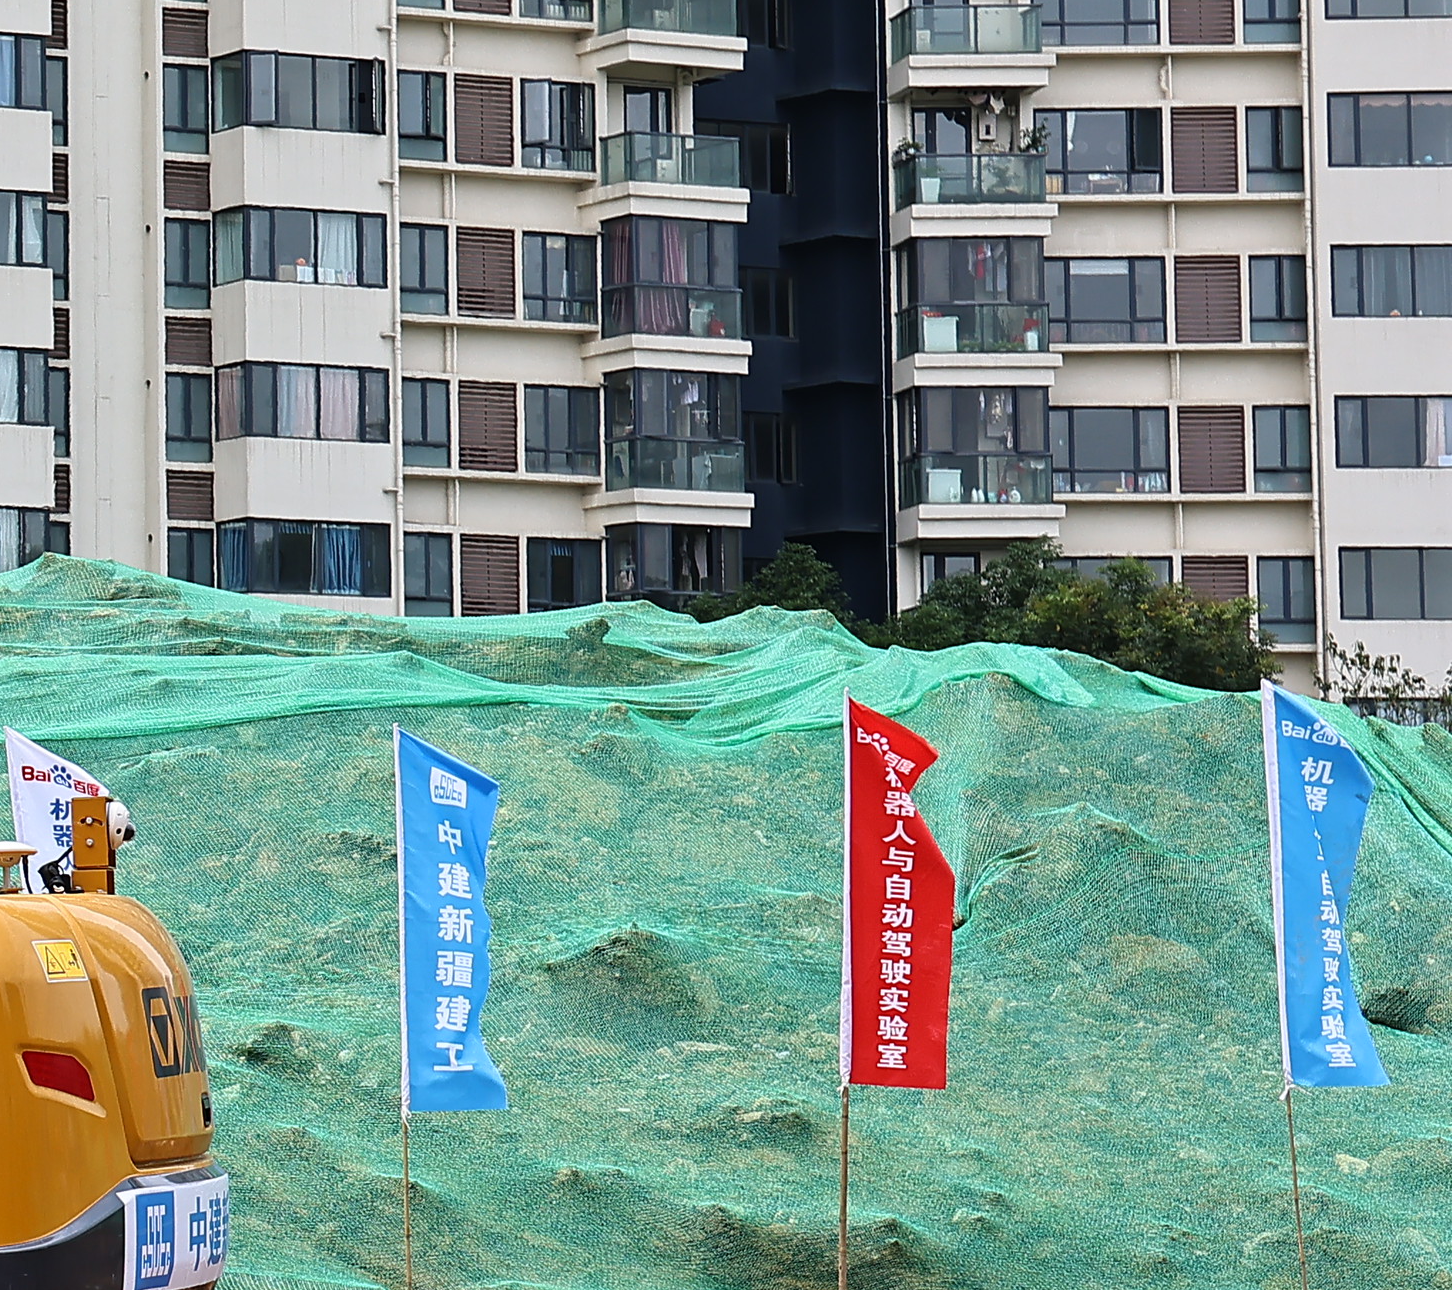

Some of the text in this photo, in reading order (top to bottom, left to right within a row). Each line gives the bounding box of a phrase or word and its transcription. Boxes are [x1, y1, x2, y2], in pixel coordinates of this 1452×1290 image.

[432, 819, 474, 1072] 中建新疆建工
